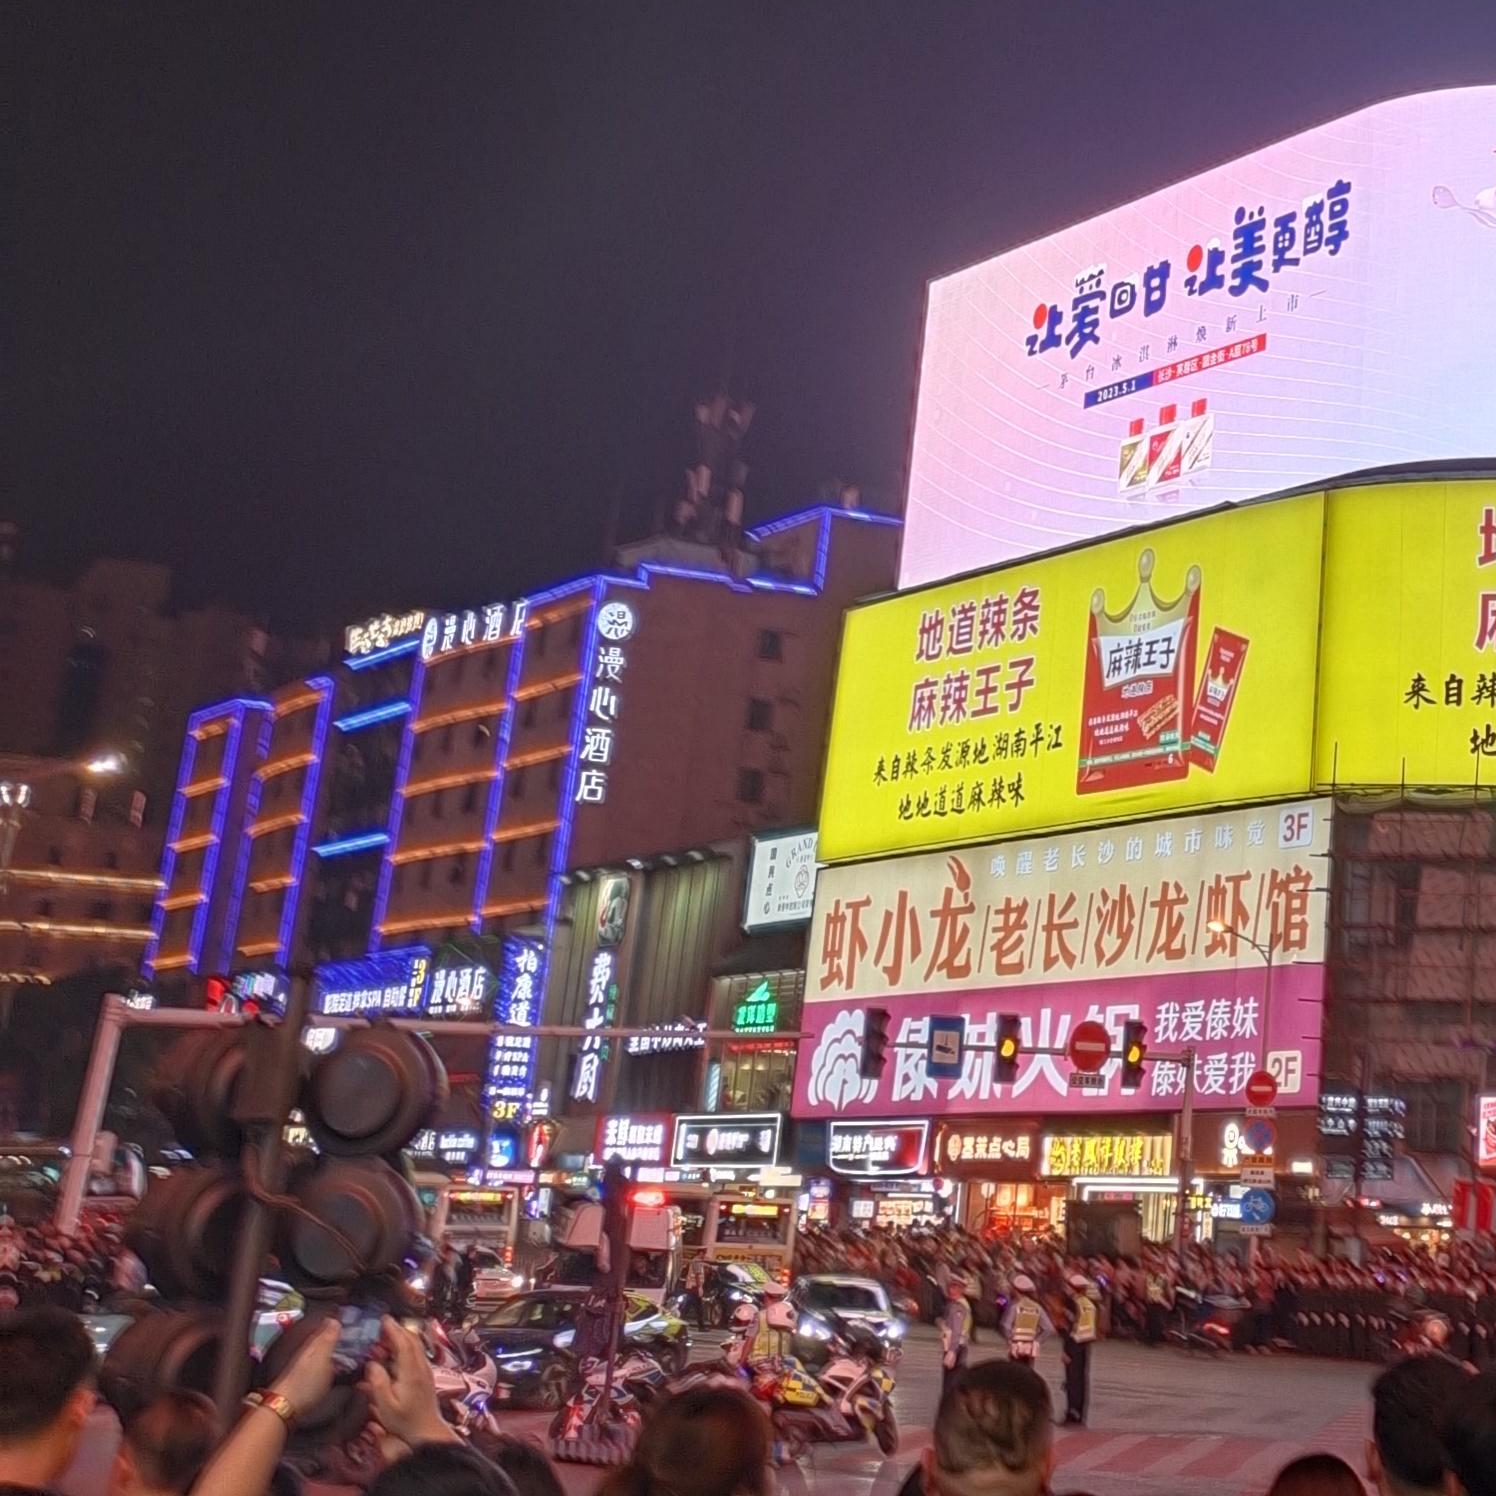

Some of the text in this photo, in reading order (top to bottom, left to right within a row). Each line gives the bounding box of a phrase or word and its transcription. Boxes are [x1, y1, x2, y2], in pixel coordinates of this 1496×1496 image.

[1025, 180, 1352, 359] 让爱回甘 让美更醇
[1096, 380, 1137, 403] 2023.5.1
[915, 586, 1042, 663] 地道辣条
[1105, 635, 1175, 679] 麻辣王子
[908, 657, 1035, 733] 麻辣王子
[575, 647, 624, 803] 漫心酒店
[872, 722, 1064, 787] 来自辣条发源地湖南平江
[897, 777, 1026, 821] 地地道道麻辣味
[1282, 811, 1309, 843] 3F
[989, 820, 1267, 878] 唤醒老长沙的城市味觉
[988, 864, 1314, 977] 老长沙龙虾馆
[1154, 996, 1259, 1044] 我爱傣妹
[491, 1100, 520, 1119] 3F
